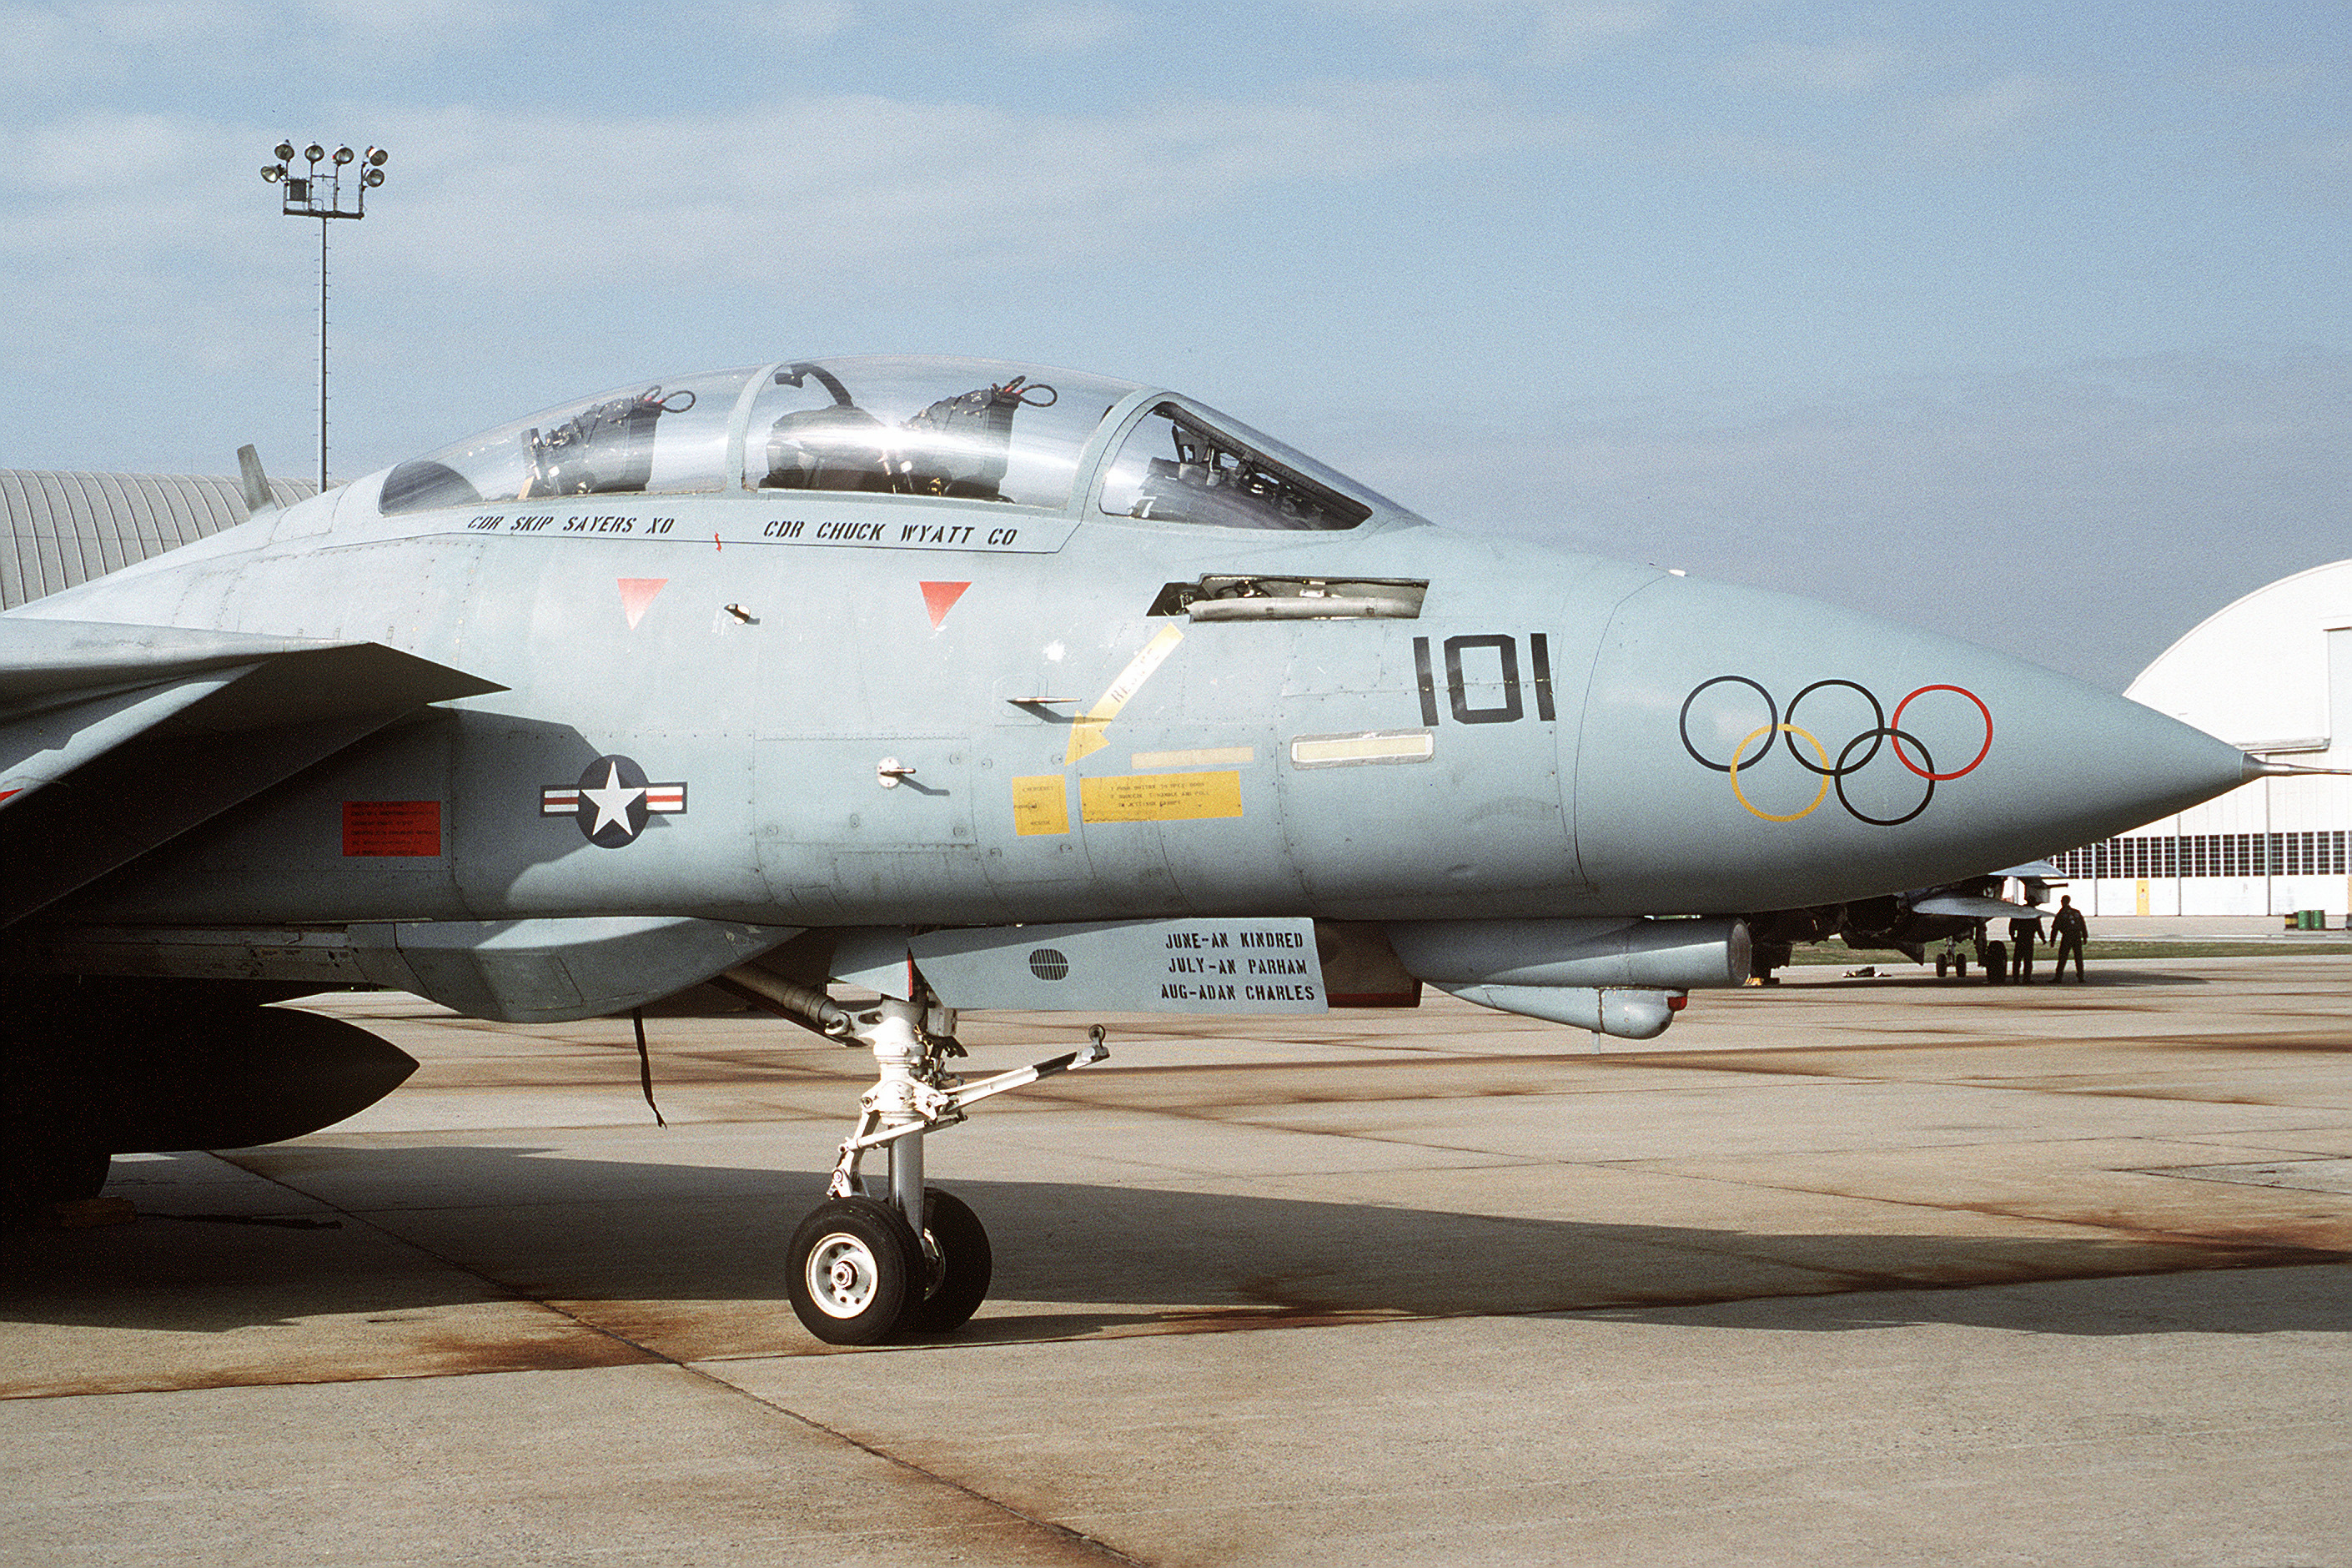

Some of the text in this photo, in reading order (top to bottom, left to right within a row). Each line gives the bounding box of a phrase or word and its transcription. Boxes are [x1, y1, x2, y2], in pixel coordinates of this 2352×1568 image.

[467, 516, 676, 534] CDR SKIP SAYERS XO
[763, 520, 1018, 545] CDR CHUCK WYATT CO
[1413, 632, 1556, 727] 101
[1165, 932, 1304, 949] JUNE-AN KINDRED
[1248, 958, 1307, 975] PARHAM
[1161, 983, 1315, 1001] AUG-ADAN CHARLES
